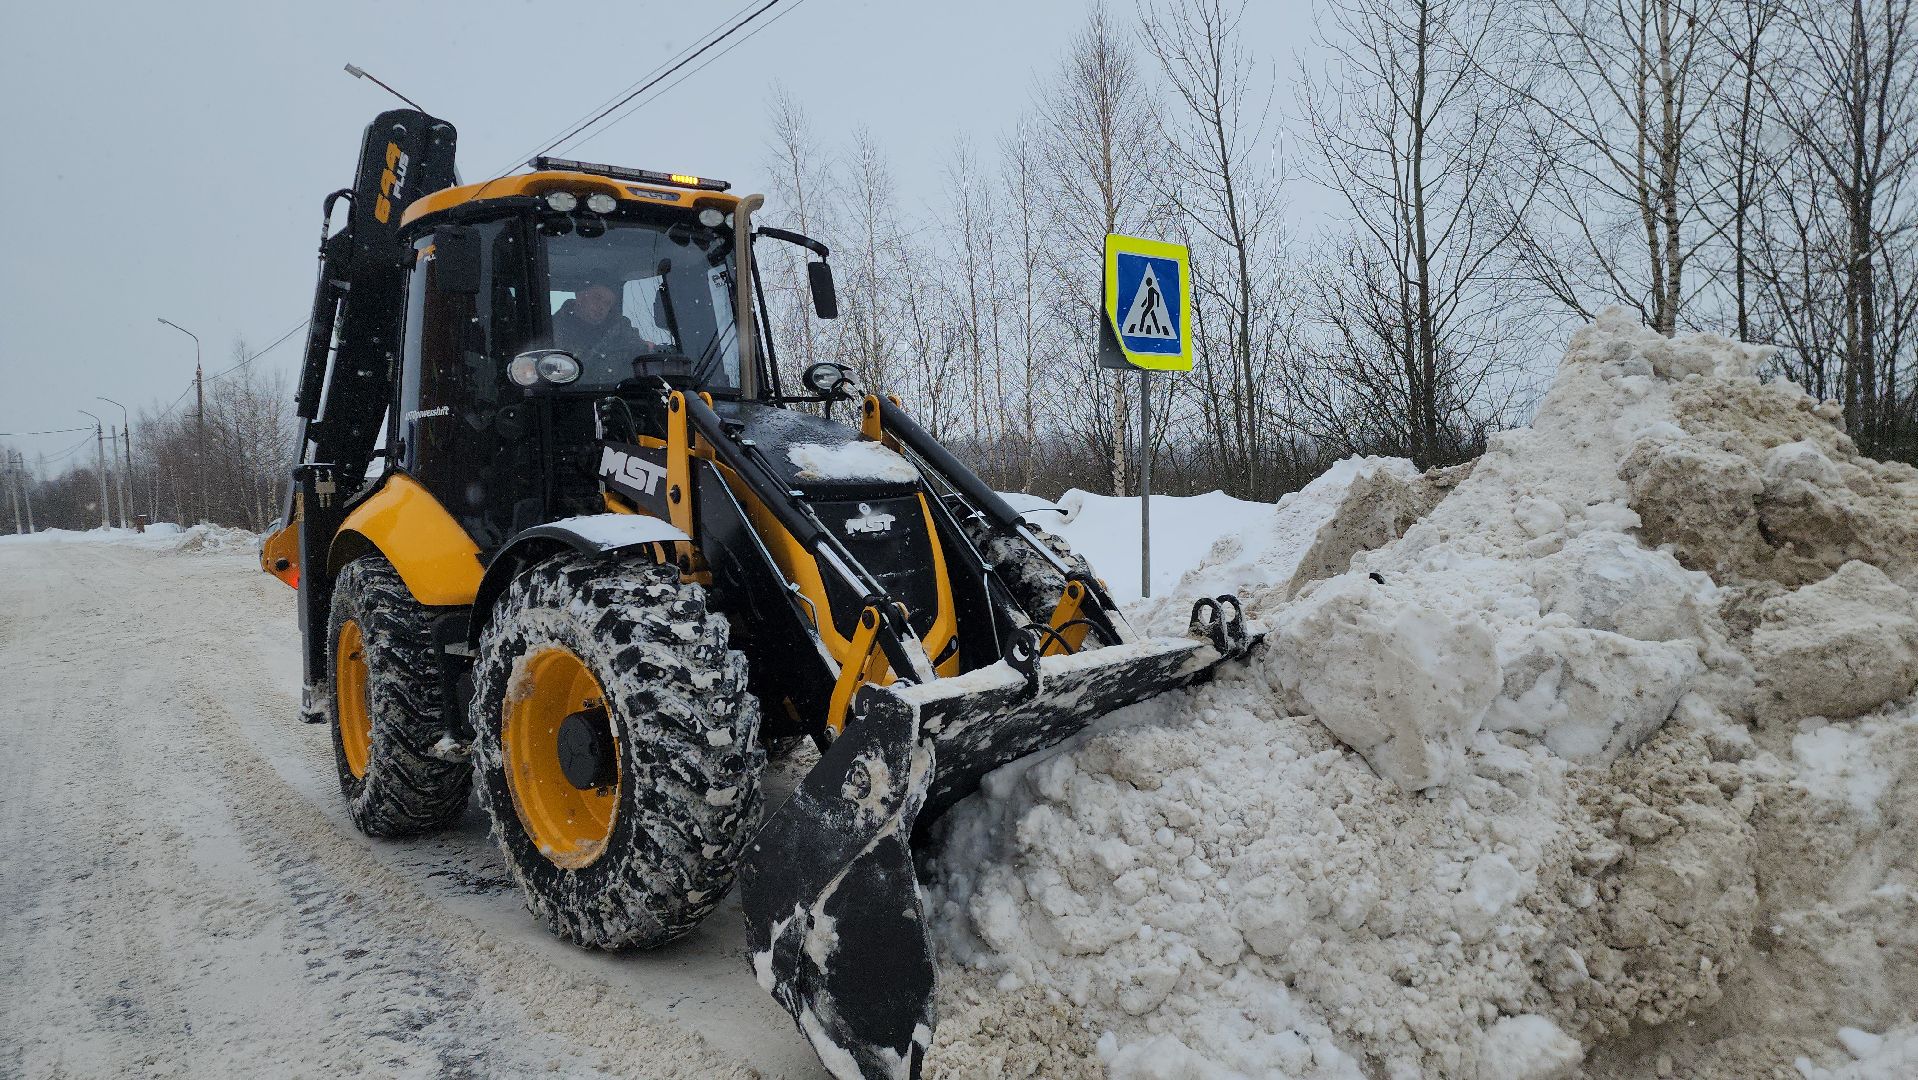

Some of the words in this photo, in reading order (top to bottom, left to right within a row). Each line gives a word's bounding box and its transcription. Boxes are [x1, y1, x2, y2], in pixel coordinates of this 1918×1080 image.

[392, 151, 409, 199] PLUS
[598, 445, 668, 497] MST
[845, 513, 896, 535] MST
